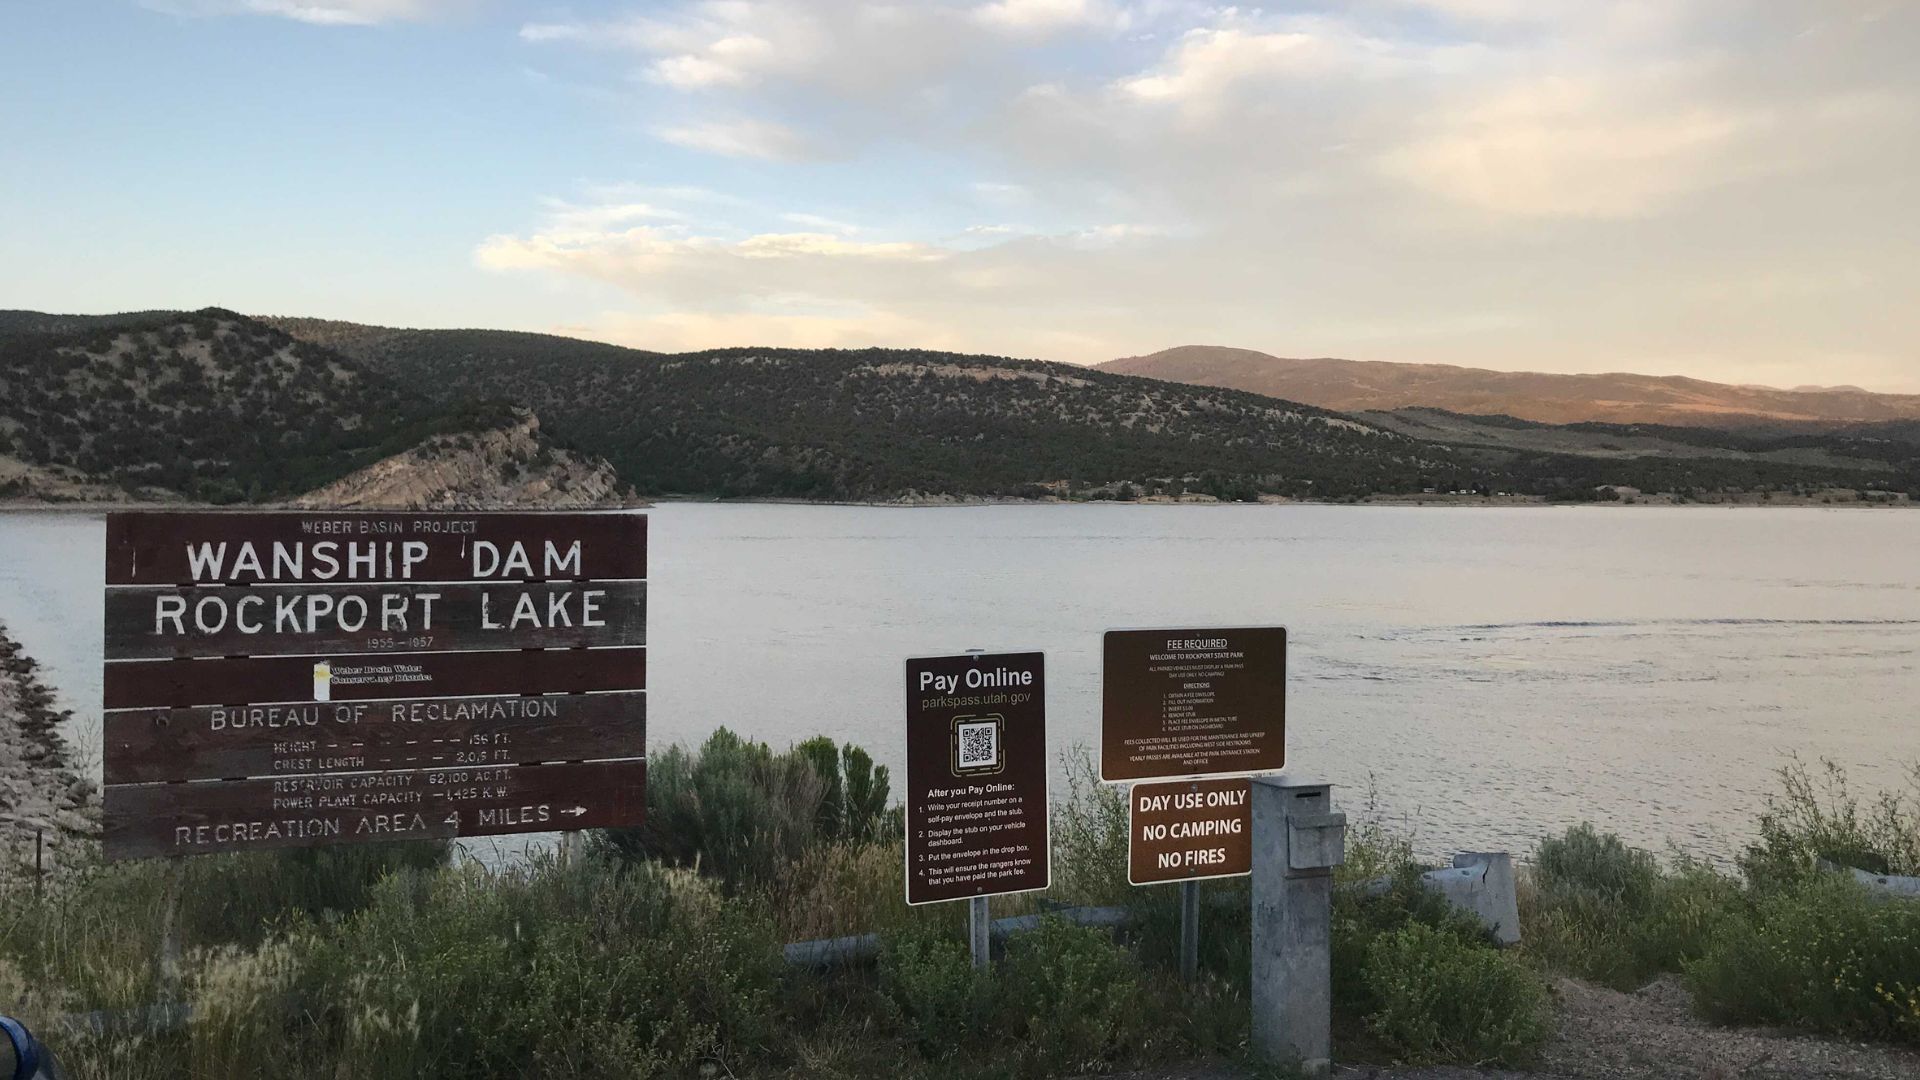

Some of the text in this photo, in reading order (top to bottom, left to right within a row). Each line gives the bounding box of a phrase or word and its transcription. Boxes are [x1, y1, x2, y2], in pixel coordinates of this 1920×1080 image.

[302, 520, 478, 534] WEBER BASIN PROJECT
[186, 539, 582, 580] WANSHIP DAM
[155, 589, 606, 636] ROCKPORT LAKE
[1167, 638, 1228, 649] FEE REQUIRED
[331, 667, 362, 675] Weber
[394, 665, 422, 673] Water
[395, 673, 433, 682] District
[920, 667, 1033, 694] Pay Online
[922, 692, 1030, 710] parkspass.utah.gov
[211, 700, 557, 731] BUREAU OF RECLAMATION
[274, 740, 317, 754] HEIGHT
[469, 733, 489, 745] 156
[274, 758, 312, 770] CREST
[318, 757, 365, 769] LENGTH
[274, 778, 344, 793] RESERVOIR
[351, 774, 413, 789] CAPACITY
[429, 772, 469, 785] 62,100
[928, 783, 1015, 798] After you Pay Online:
[273, 796, 313, 810] POWER
[318, 794, 357, 807] PLANT
[363, 791, 422, 804] CAPACITY
[928, 803, 945, 811] Write
[946, 802, 961, 811] your
[961, 799, 983, 808] receipt
[984, 797, 1008, 805] number
[1140, 790, 1246, 812] DAY USE ONLY
[928, 814, 953, 823] self-pay
[954, 812, 983, 820] envelope
[997, 809, 1008, 817] the
[1008, 807, 1024, 816] stub.
[175, 805, 551, 846] RECREATION AREA 4 MILES
[928, 829, 952, 838] Display
[989, 824, 1003, 833] your
[1004, 821, 1026, 829] vehicle
[1143, 818, 1242, 841] NO CAMPING
[928, 837, 963, 847] dashboard.
[928, 853, 940, 861] Put
[952, 849, 981, 858] envelope
[1000, 846, 1015, 854] drop
[1158, 848, 1226, 869] NO FIRES
[928, 868, 943, 876] This
[943, 866, 954, 874] will
[955, 864, 977, 872] ensure
[978, 862, 989, 870] the
[989, 860, 1014, 869] rangers
[1014, 858, 1032, 866] know
[942, 877, 955, 885] you
[972, 872, 986, 882] paid
[998, 869, 1013, 878] park
[1013, 867, 1025, 875] fee.
